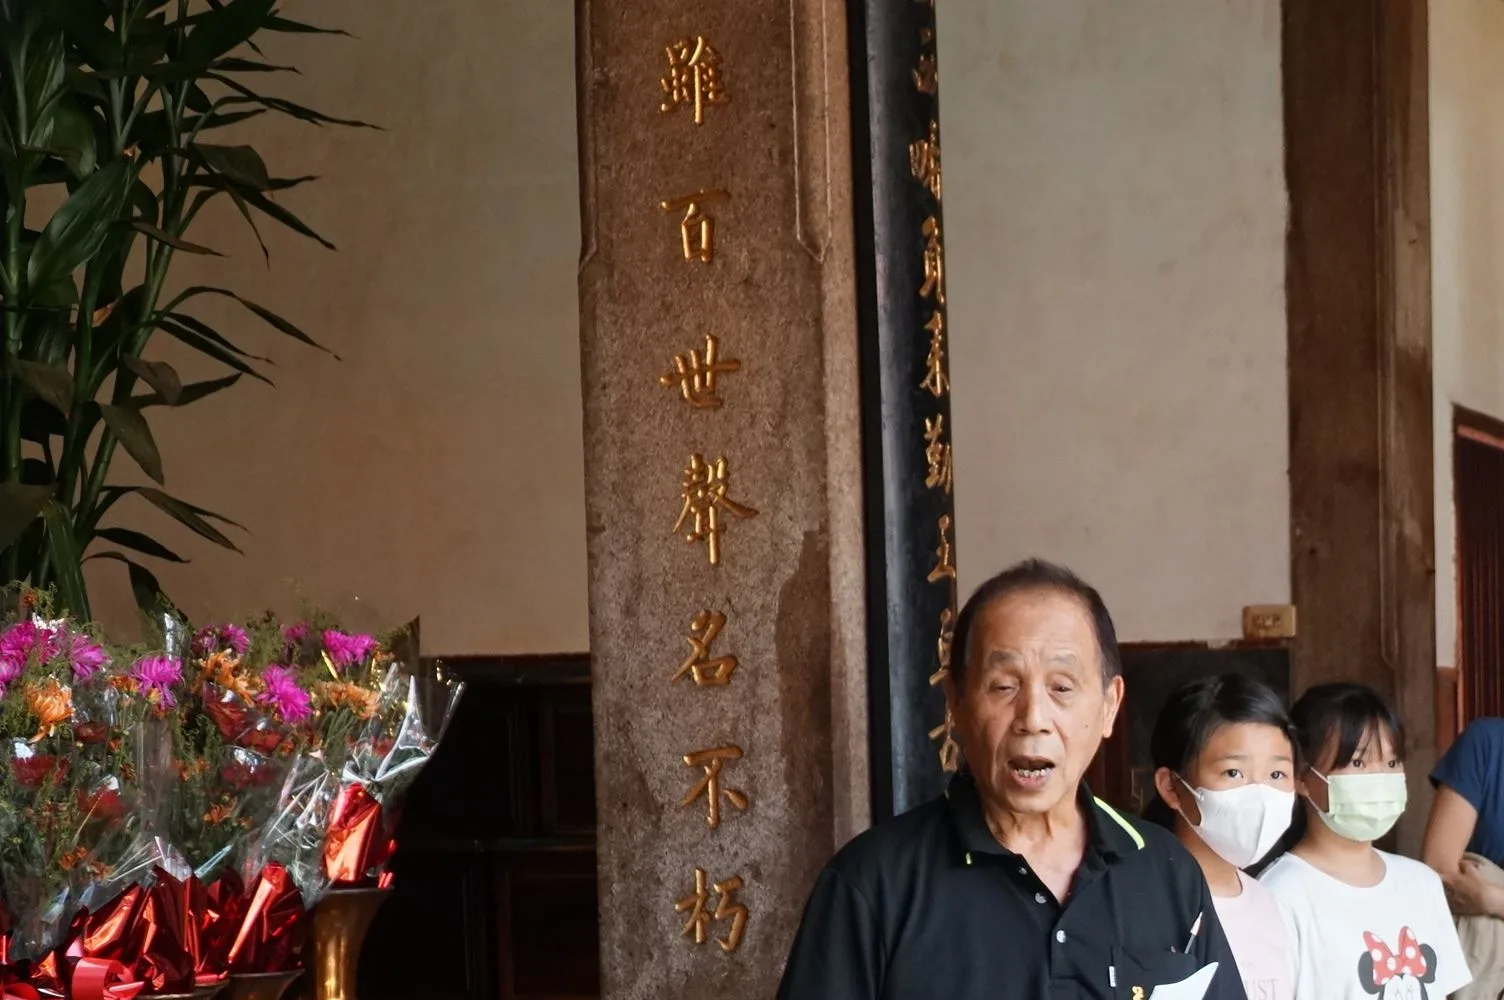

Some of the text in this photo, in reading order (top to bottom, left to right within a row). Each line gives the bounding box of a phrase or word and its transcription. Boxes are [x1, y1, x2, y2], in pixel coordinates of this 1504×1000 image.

[658, 35, 760, 953] 雖百世聲名不朽
